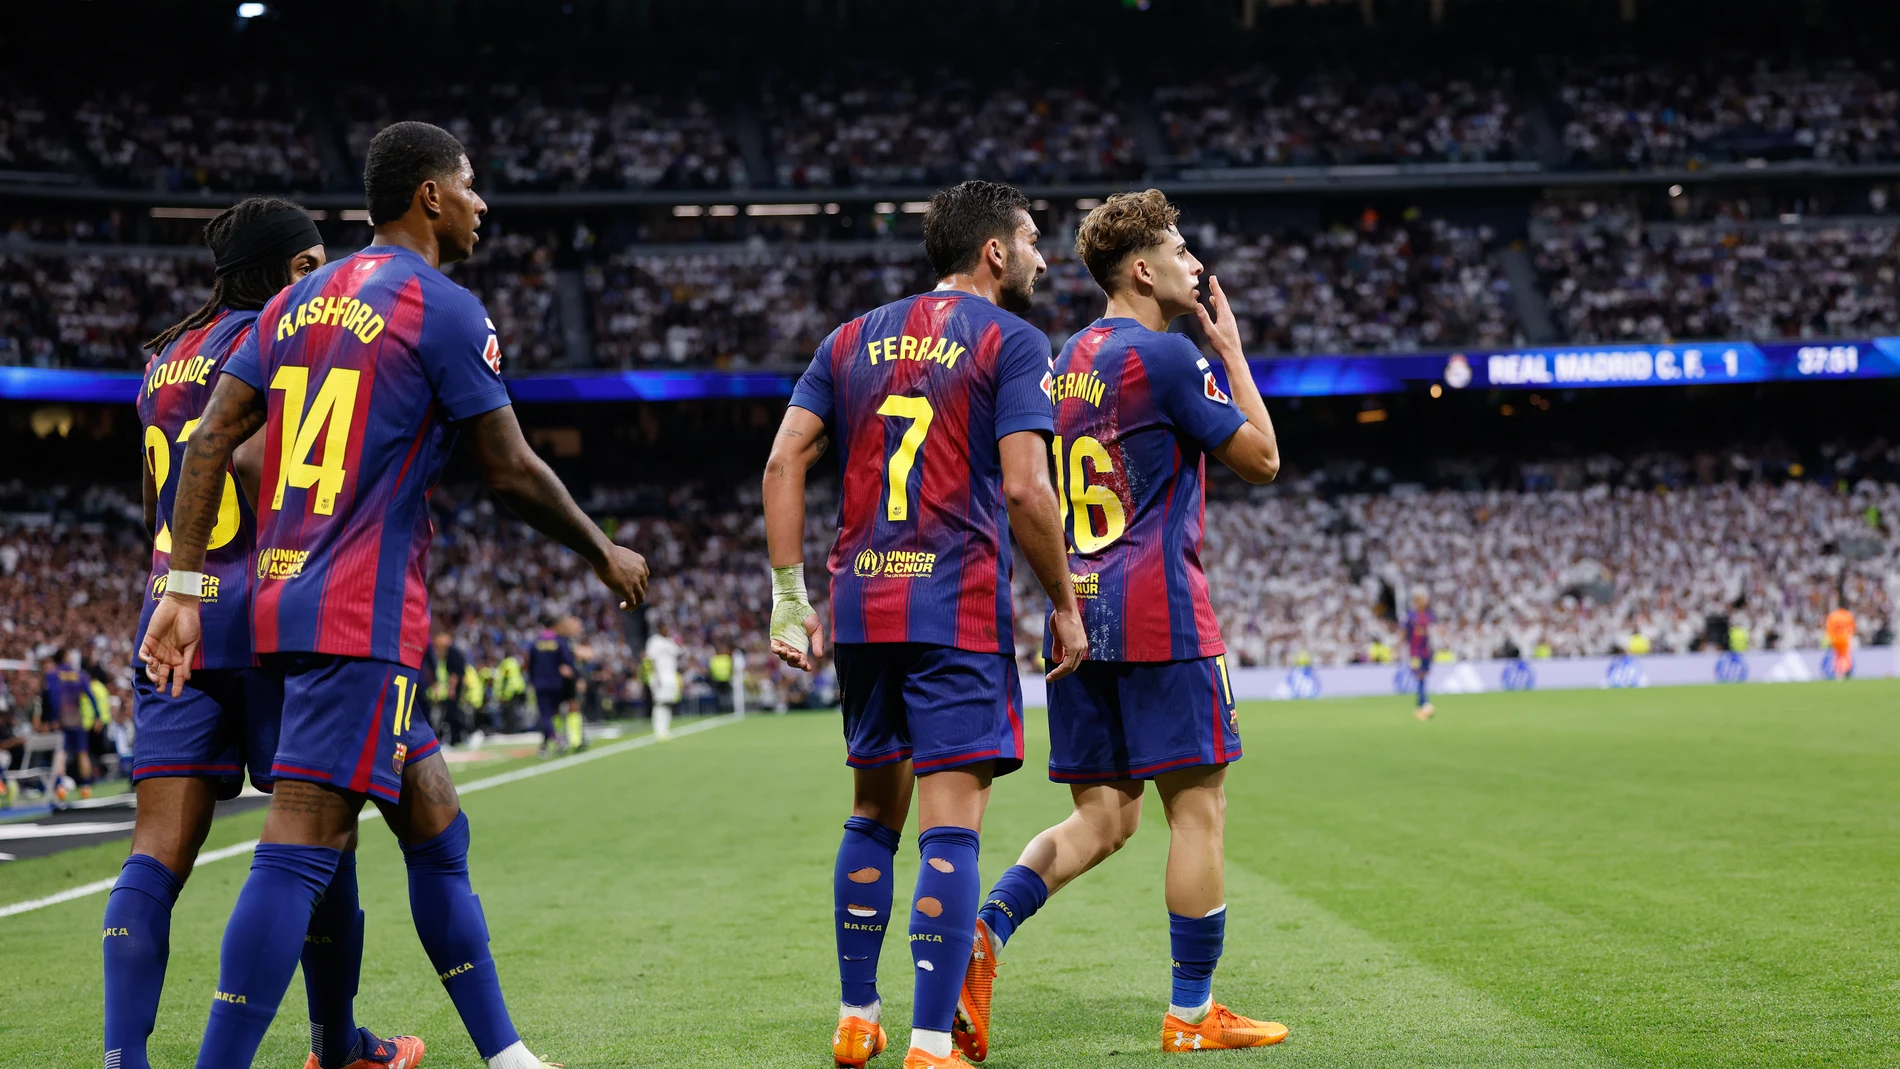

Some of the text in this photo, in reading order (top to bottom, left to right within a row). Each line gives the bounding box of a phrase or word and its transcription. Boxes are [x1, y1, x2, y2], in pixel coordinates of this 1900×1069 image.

[277, 296, 385, 344] RASHFORD
[867, 335, 966, 370] FERRAN
[1488, 354, 1554, 384] REAL
[1554, 351, 1653, 382] MADRID
[1721, 348, 1739, 377] 1
[147, 355, 217, 399] KOUNDE
[1051, 369, 1107, 408] FERMÍN
[269, 365, 361, 516] 14
[876, 394, 935, 522] 7
[1052, 434, 1125, 554] 16
[884, 562, 933, 573] ACNUR
[886, 551, 936, 562] UNHCR
[1072, 583, 1099, 595] NUR
[103, 927, 129, 938] ARÇA
[843, 922, 882, 932] BARÇA
